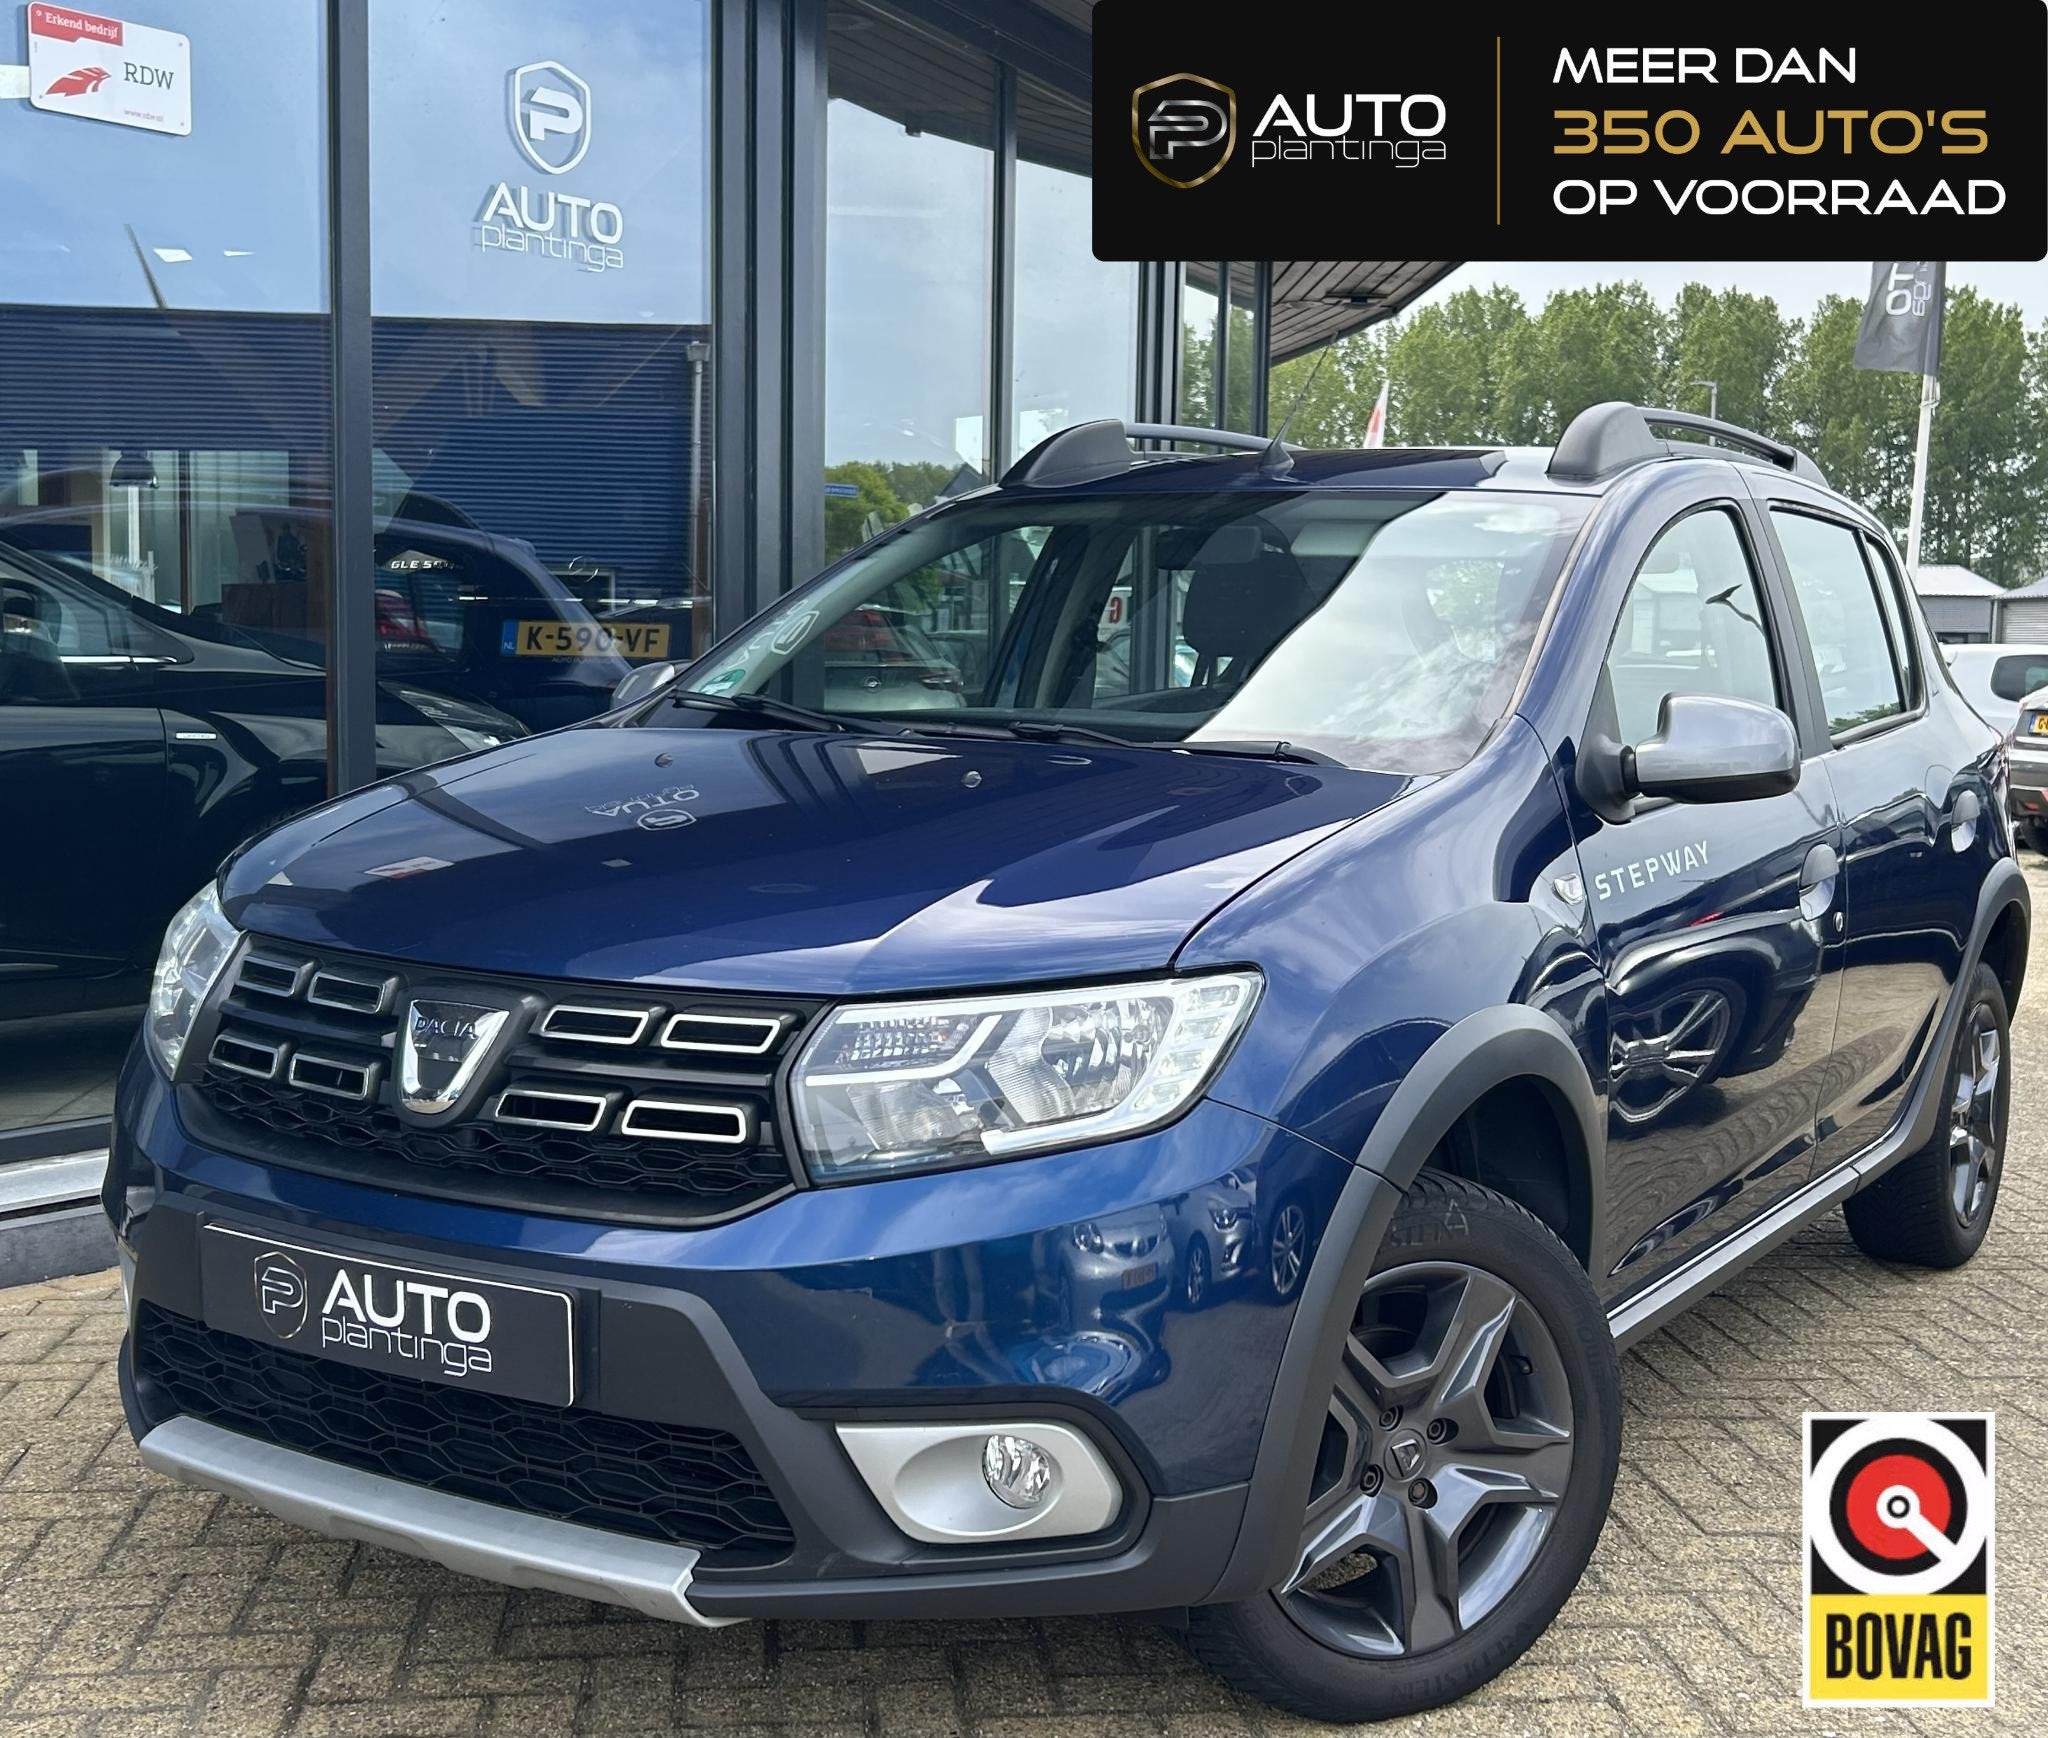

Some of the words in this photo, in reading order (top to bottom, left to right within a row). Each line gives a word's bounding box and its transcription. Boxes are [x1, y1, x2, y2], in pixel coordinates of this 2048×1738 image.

[45, 12, 83, 31] Erkend
[85, 22, 119, 40] bedrijf
[124, 62, 175, 90] RDW
[483, 182, 623, 245] AUTO
[482, 224, 624, 272] plantinga
[391, 560, 420, 569] GLE
[1594, 840, 1709, 901] STEPWAY
[414, 1017, 480, 1040] DACIA
[322, 1268, 492, 1344] AUTO
[322, 1315, 493, 1378] plantinga
